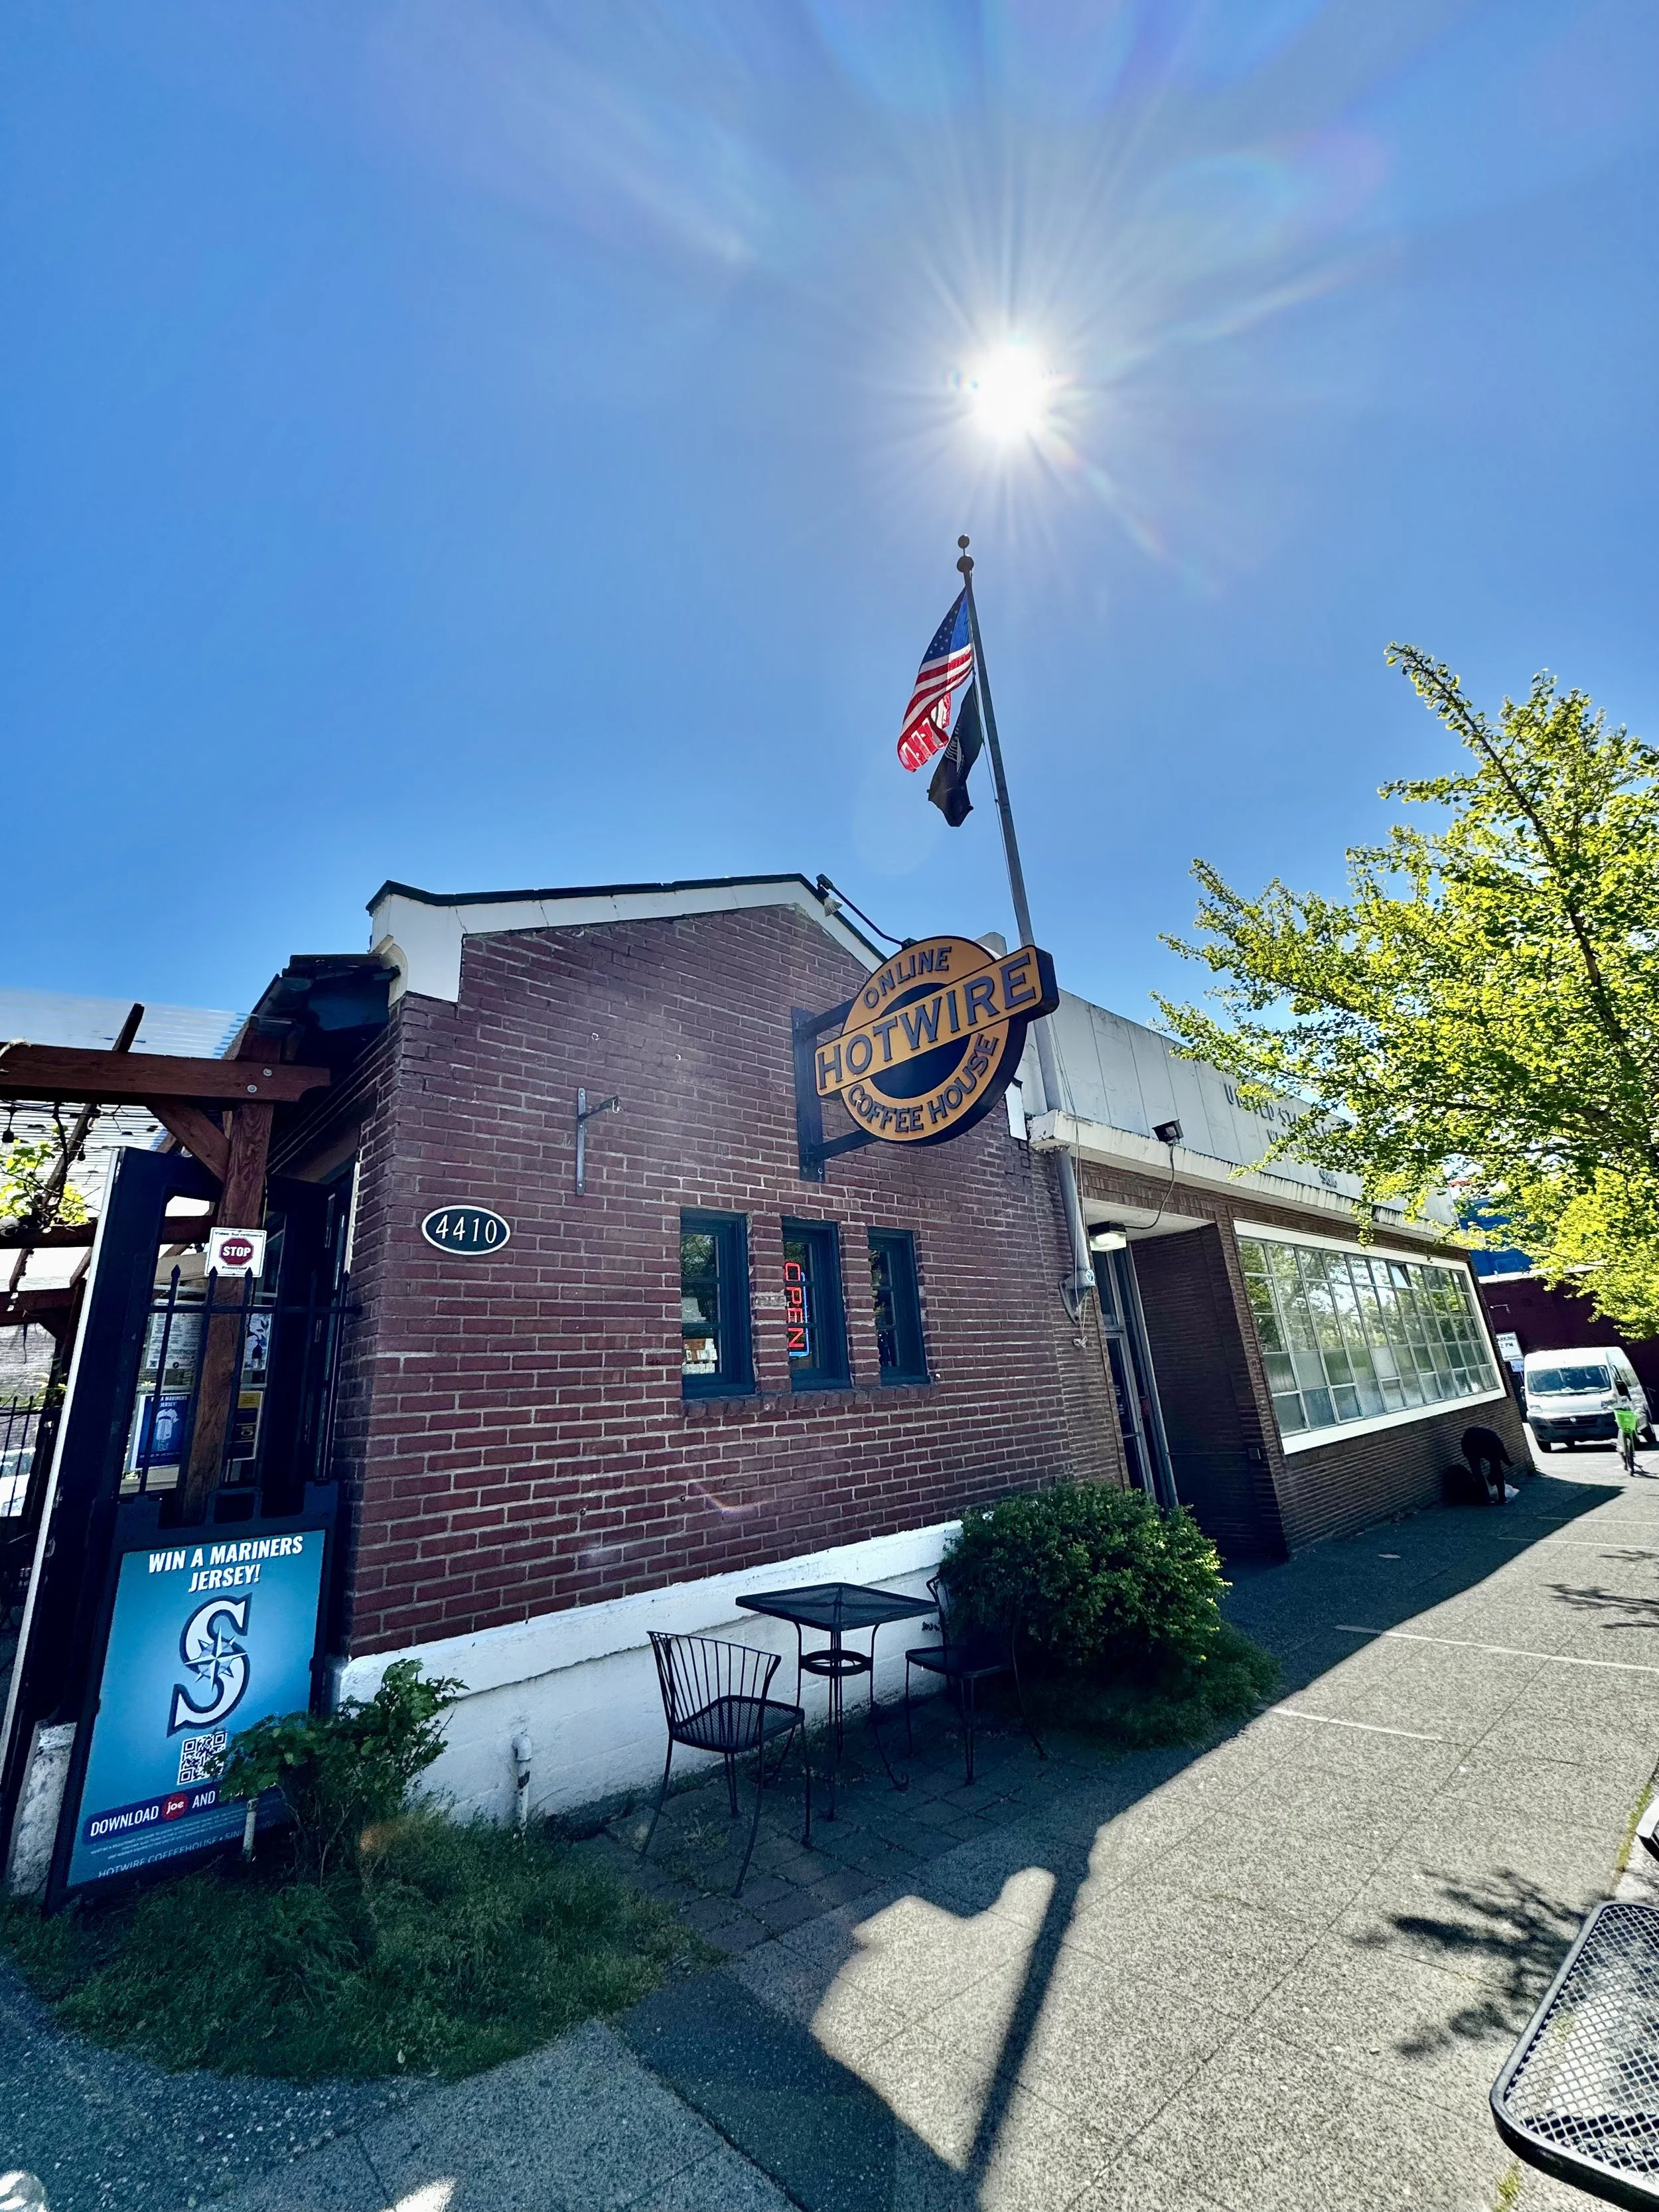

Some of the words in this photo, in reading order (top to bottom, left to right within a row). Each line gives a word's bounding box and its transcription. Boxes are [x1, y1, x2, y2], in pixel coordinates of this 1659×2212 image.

[863, 946, 952, 1009] ONLINE
[817, 952, 1037, 1090] HOTWIRE
[848, 1083, 924, 1132] COFFEE
[927, 1032, 999, 1124] HOUSE
[222, 1246, 252, 1257] STOP
[435, 1214, 497, 1244] 4410
[784, 1262, 804, 1347] OPEN
[149, 1550, 186, 1573] WIN
[190, 1548, 203, 1568] A
[210, 1535, 303, 1566] MARINERS
[188, 1564, 261, 1593] JERSEY!
[90, 1805, 159, 1836] DOWNLOAD
[166, 1801, 184, 1814] joe
[192, 1790, 216, 1808] AND
